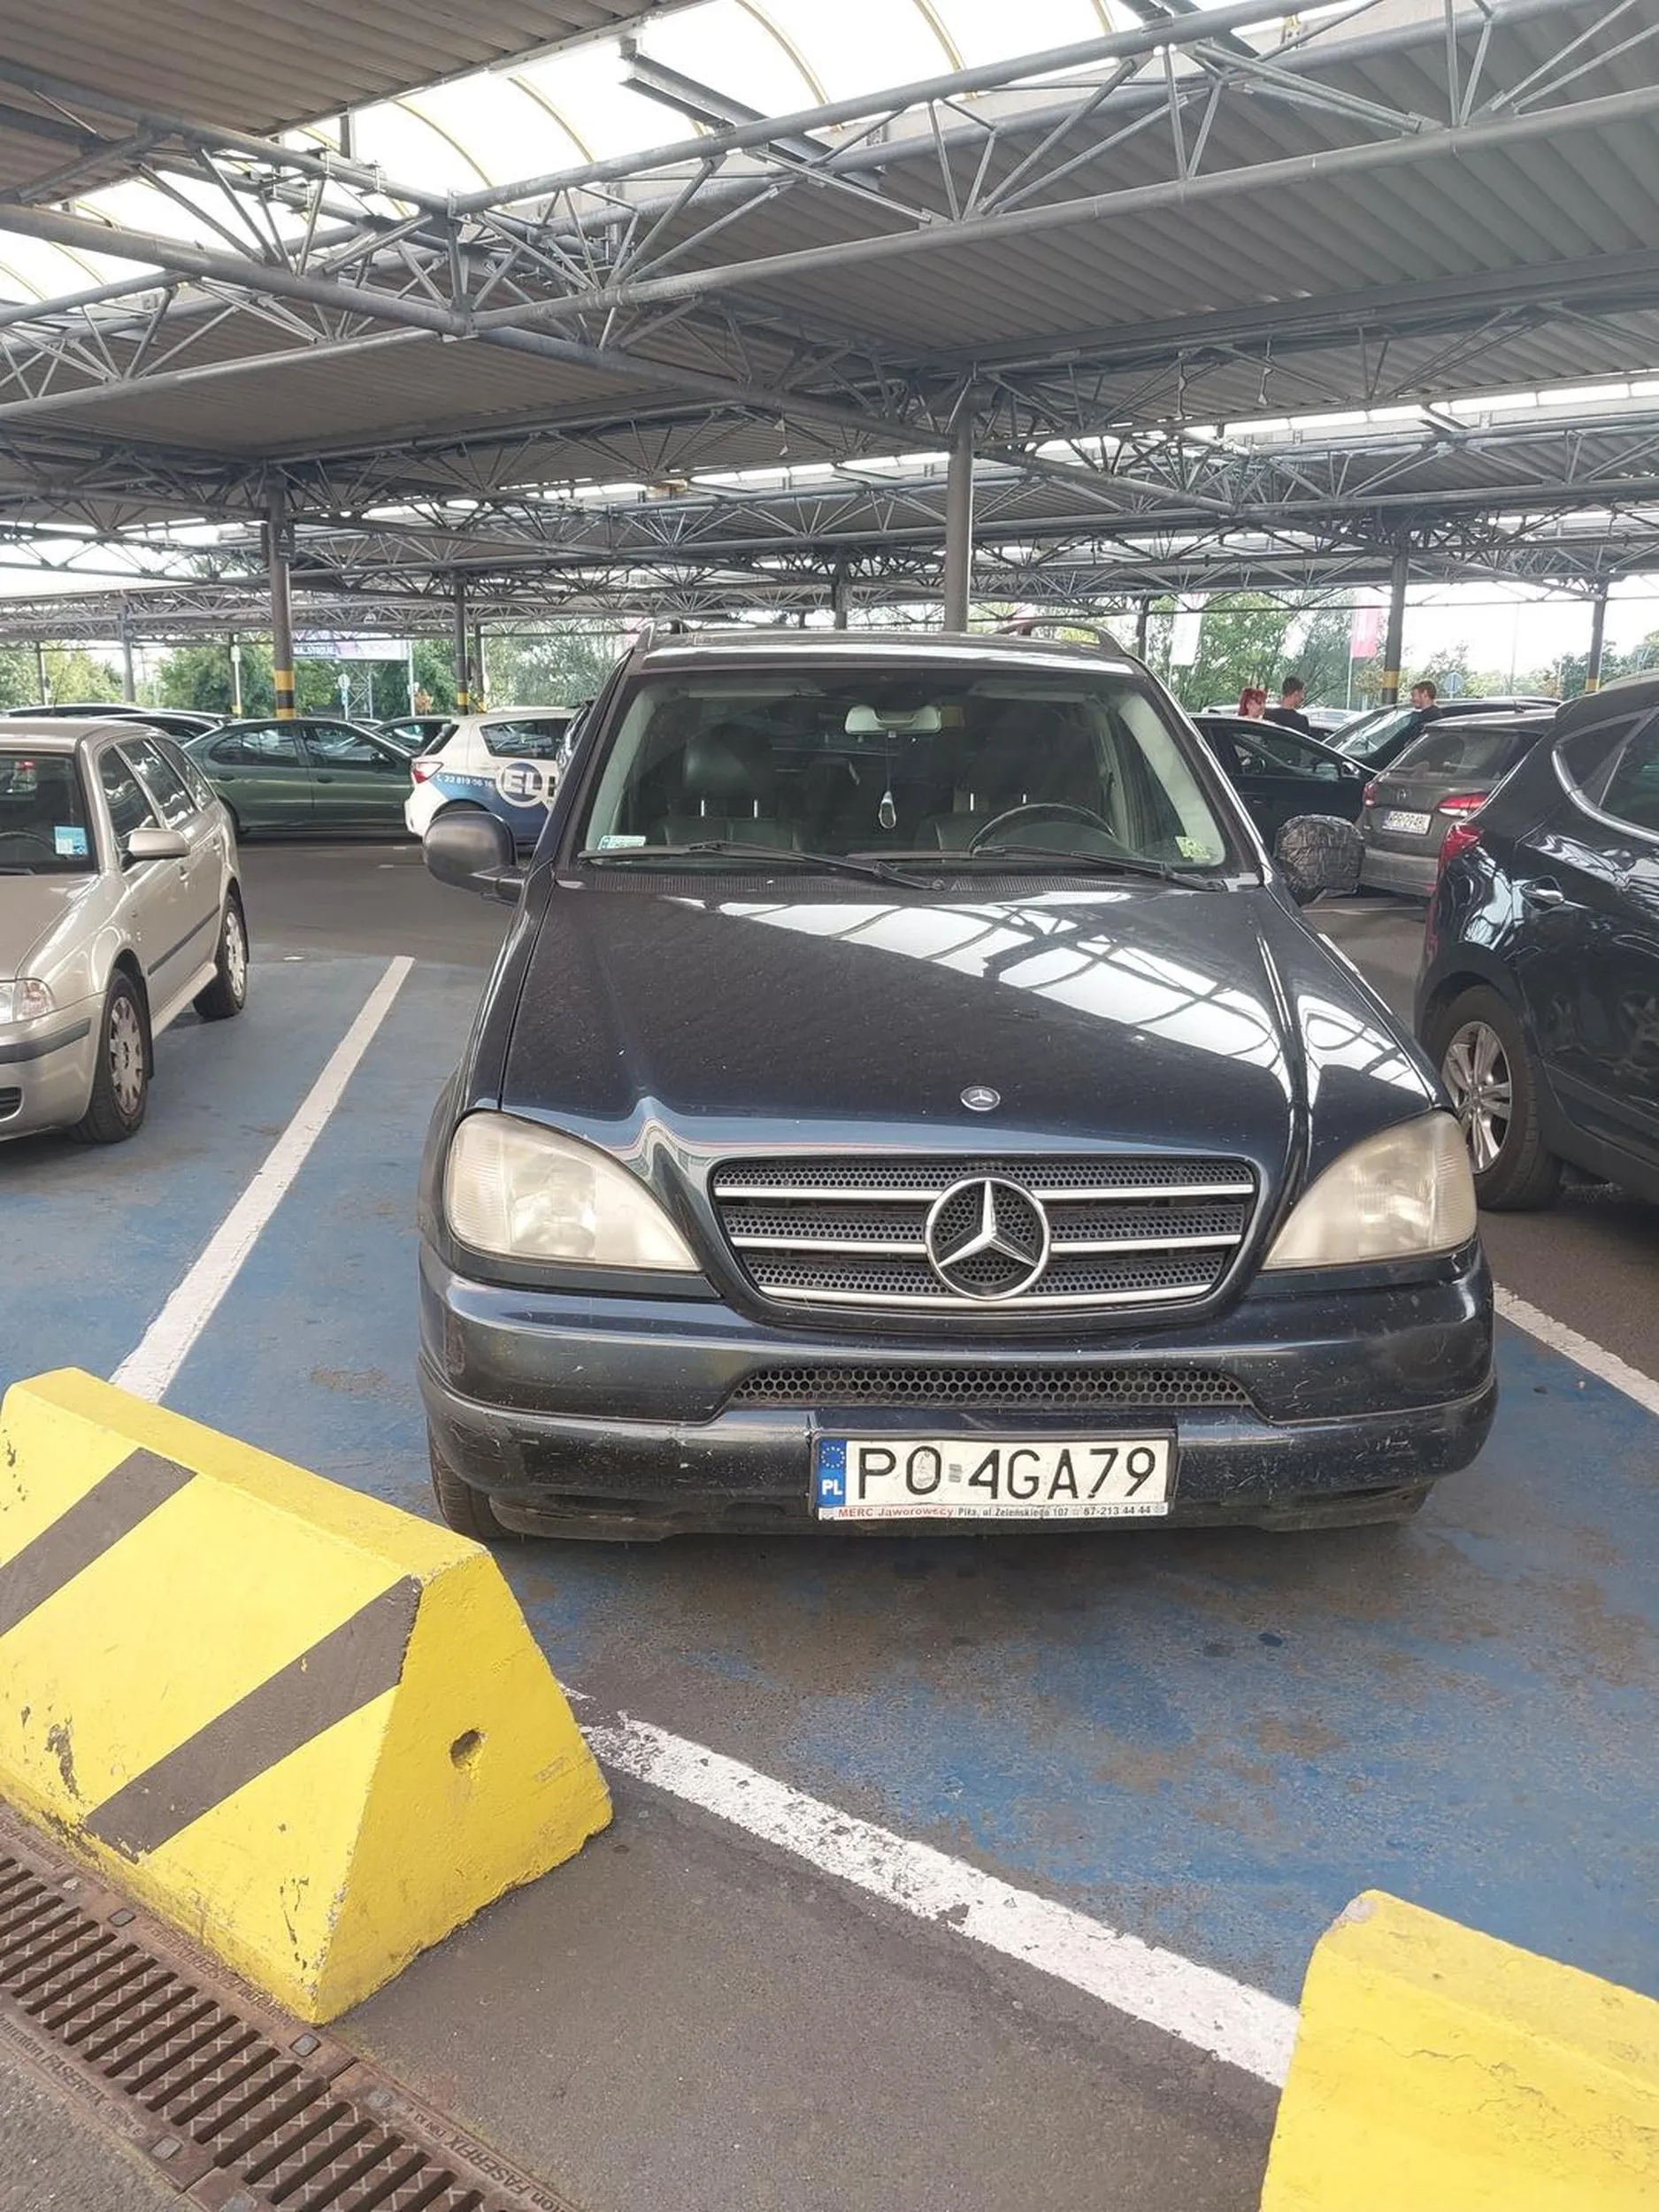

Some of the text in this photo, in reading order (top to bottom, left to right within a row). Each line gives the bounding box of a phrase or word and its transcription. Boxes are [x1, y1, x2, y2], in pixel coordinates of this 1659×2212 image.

[821, 1479, 843, 1496] PL
[857, 1445, 1156, 1500] PO 4GA79
[838, 1508, 873, 1517] MERC
[1053, 1507, 1069, 1516] 107
[1122, 1505, 1134, 1514] 44
[1138, 1505, 1151, 1514] 44
[42, 2054, 111, 2107] FASERFIX
[445, 2134, 533, 2198] FASERFIX
